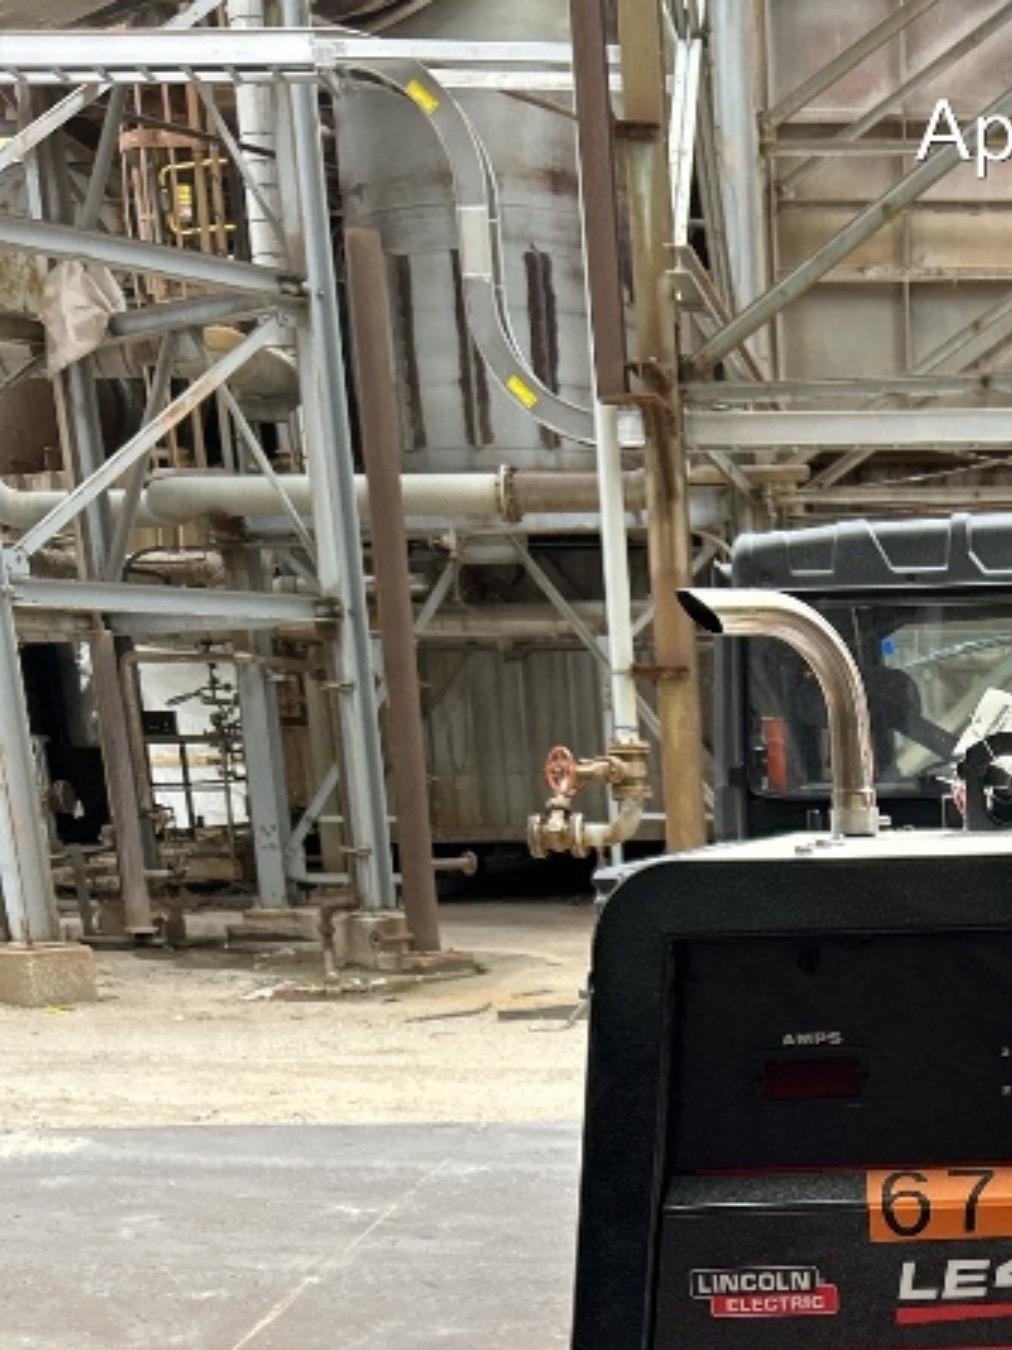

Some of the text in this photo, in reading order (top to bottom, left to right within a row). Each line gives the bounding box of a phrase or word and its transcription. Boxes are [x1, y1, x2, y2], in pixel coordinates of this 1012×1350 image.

[782, 1031, 842, 1046] AMPS
[697, 1271, 811, 1294] LINCOLN
[725, 1295, 826, 1313] ELECTRIC
